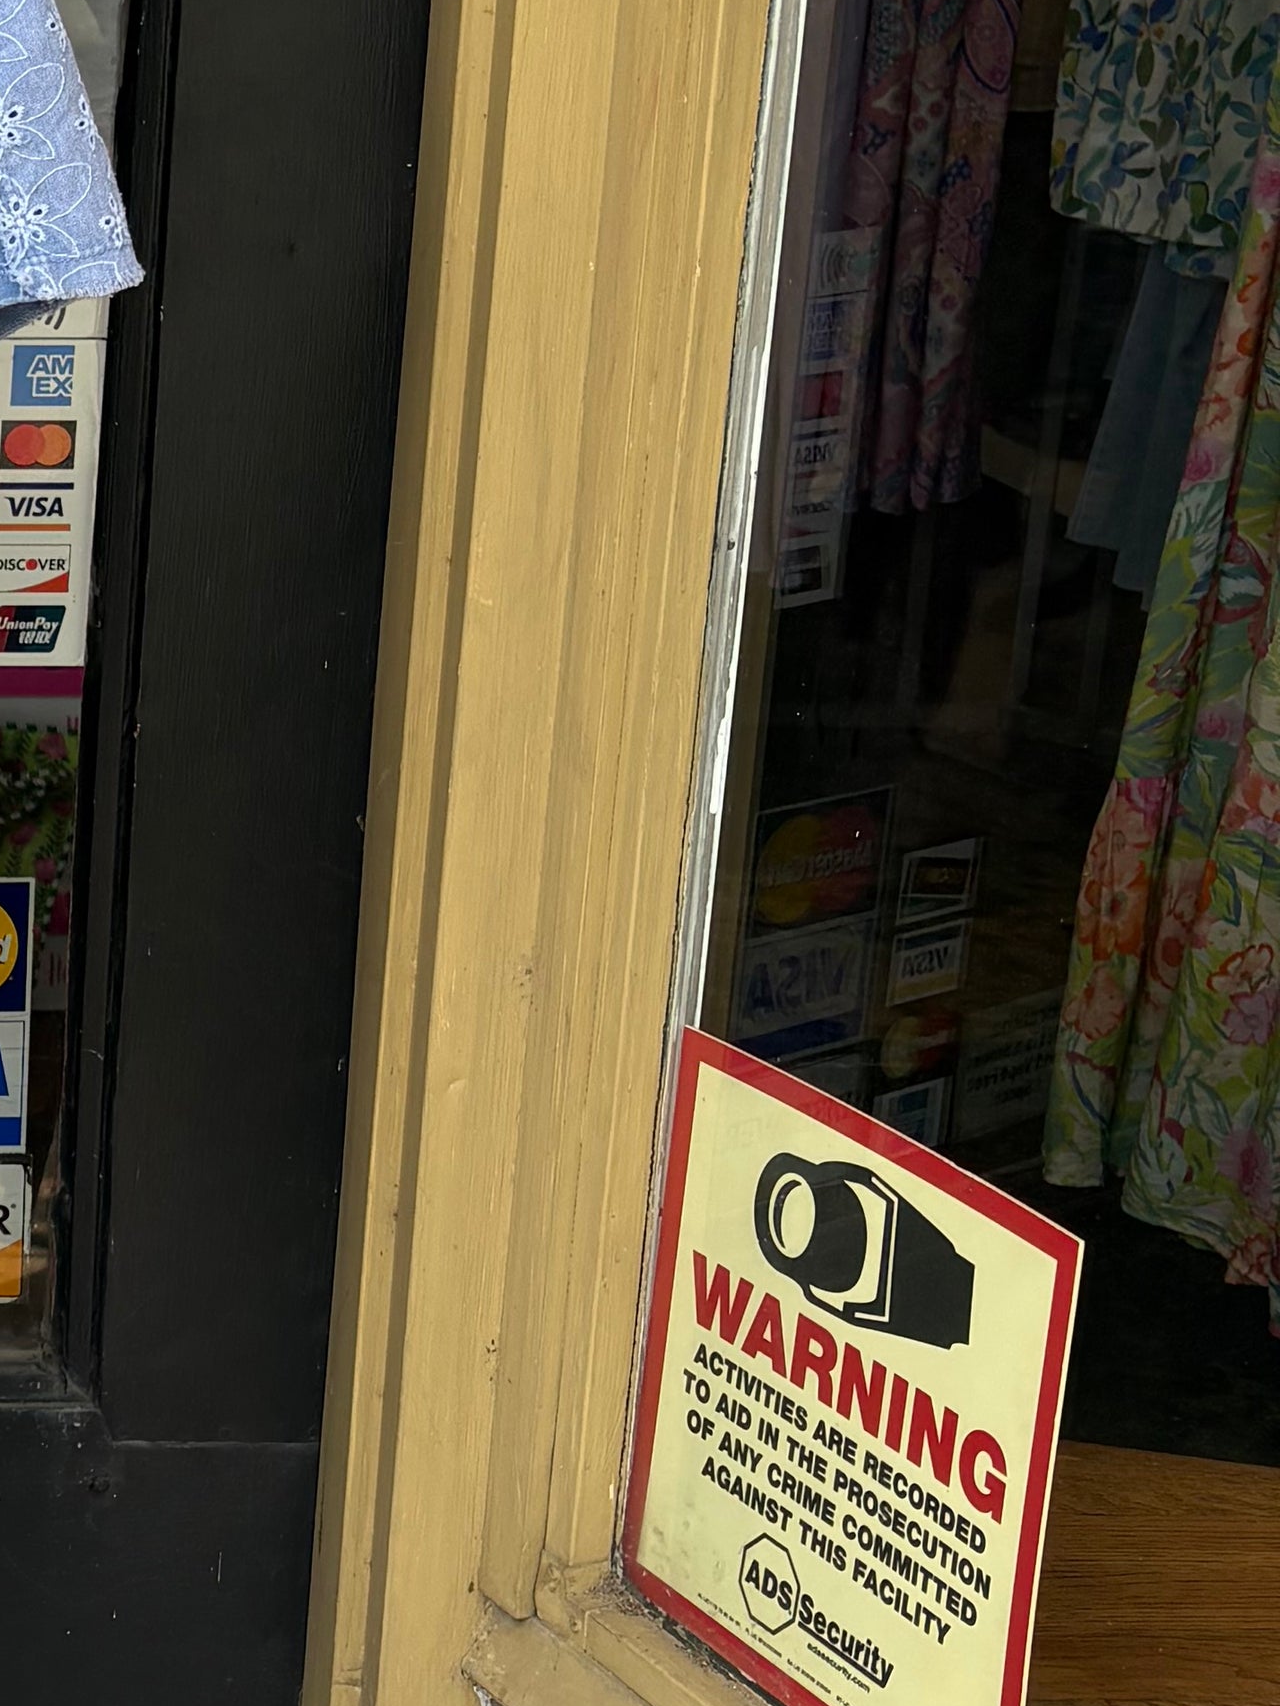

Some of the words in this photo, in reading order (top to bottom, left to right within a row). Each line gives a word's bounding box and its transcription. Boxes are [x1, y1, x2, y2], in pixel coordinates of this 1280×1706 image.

[27, 354, 74, 376] AM
[32, 375, 73, 397] EX
[5, 497, 64, 517] VISA
[692, 1249, 1008, 1526] WARNING
[693, 1343, 808, 1432] ACTIVITIES
[813, 1419, 858, 1466] ARE
[863, 1450, 987, 1555] RECORDED
[683, 1368, 711, 1405] TO
[715, 1393, 752, 1431] AID
[757, 1418, 780, 1451] IN
[786, 1435, 828, 1484] THE
[833, 1468, 992, 1601] PROSECUTION
[687, 1409, 715, 1441] OF
[718, 1431, 763, 1473] ANY
[767, 1462, 837, 1527] CRIME
[842, 1514, 978, 1627] COMMITTED
[701, 1456, 793, 1532] AGAINST
[799, 1518, 848, 1572] THIS
[852, 1557, 952, 1645] FACILITY
[745, 1559, 793, 1611] ADS
[798, 1594, 894, 1686] Security
